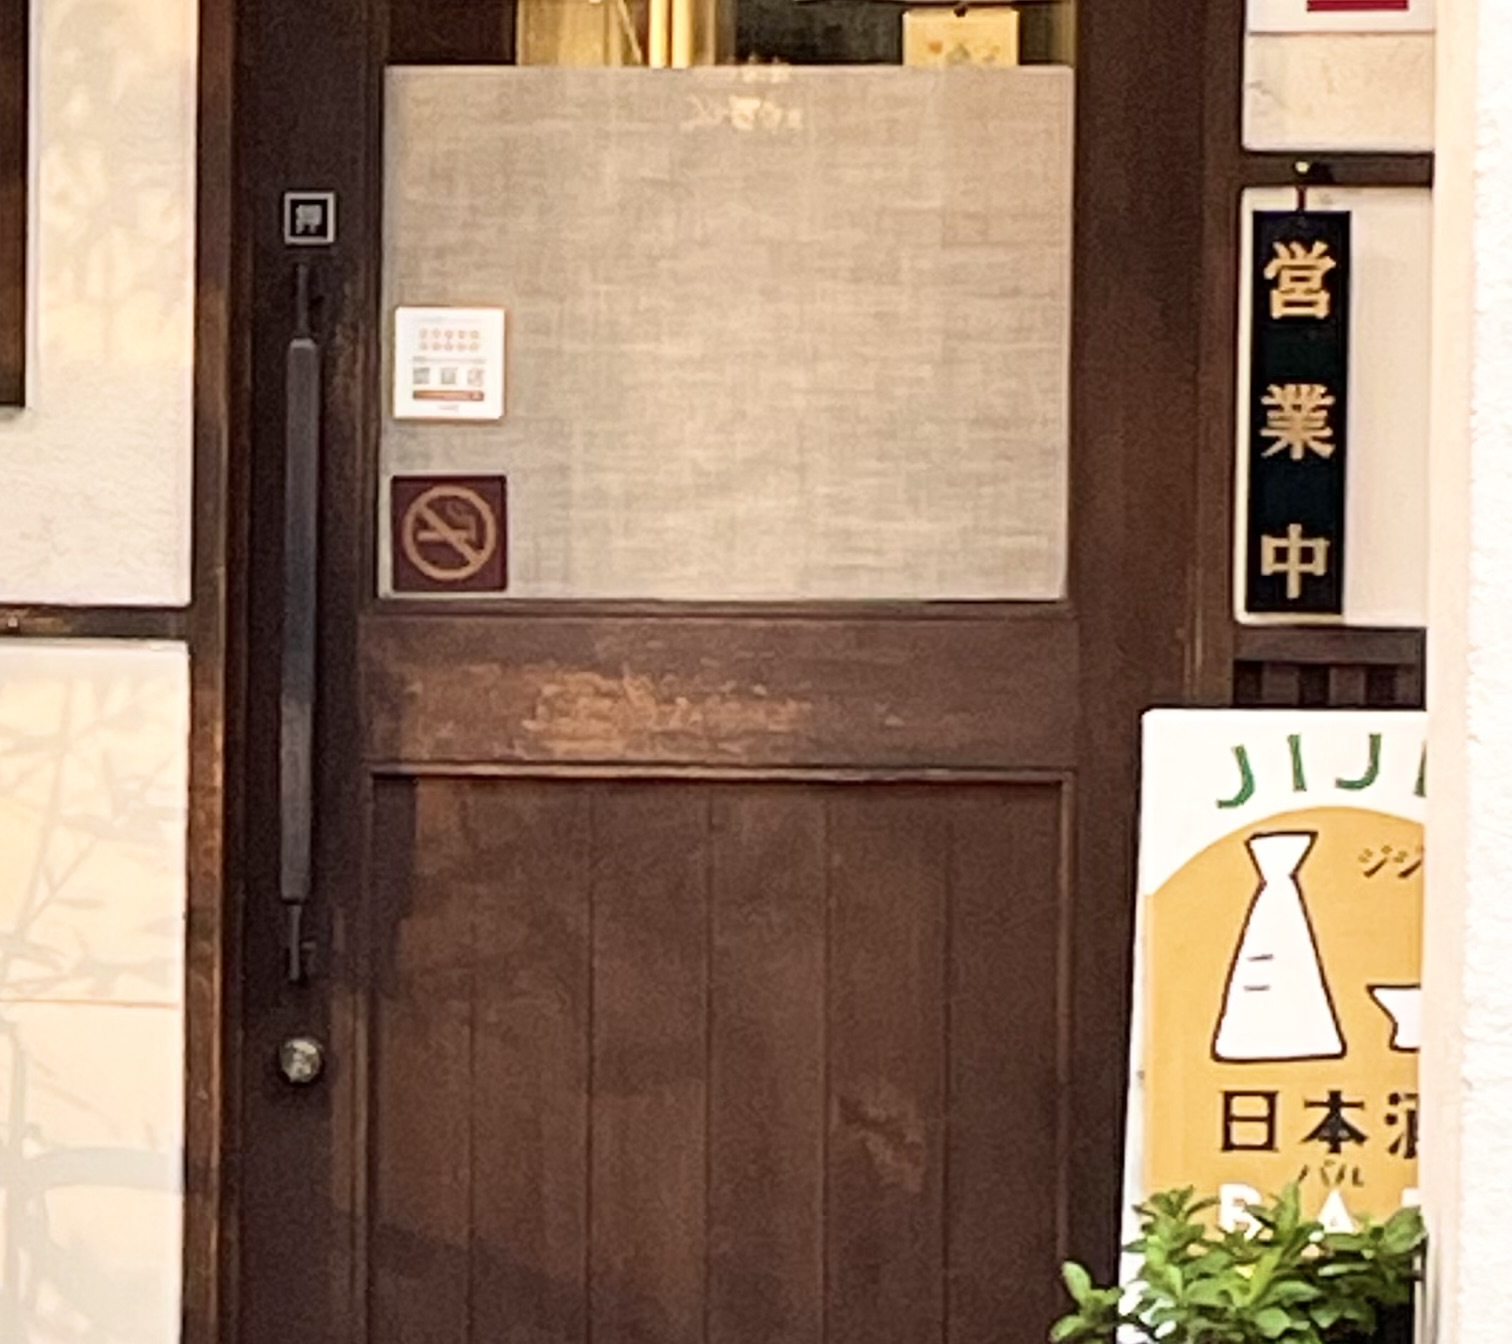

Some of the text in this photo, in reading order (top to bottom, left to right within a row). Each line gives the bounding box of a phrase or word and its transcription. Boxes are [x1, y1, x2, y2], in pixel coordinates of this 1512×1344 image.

[1260, 240, 1336, 600] 営業中
[1220, 1183, 1420, 1239] BA
